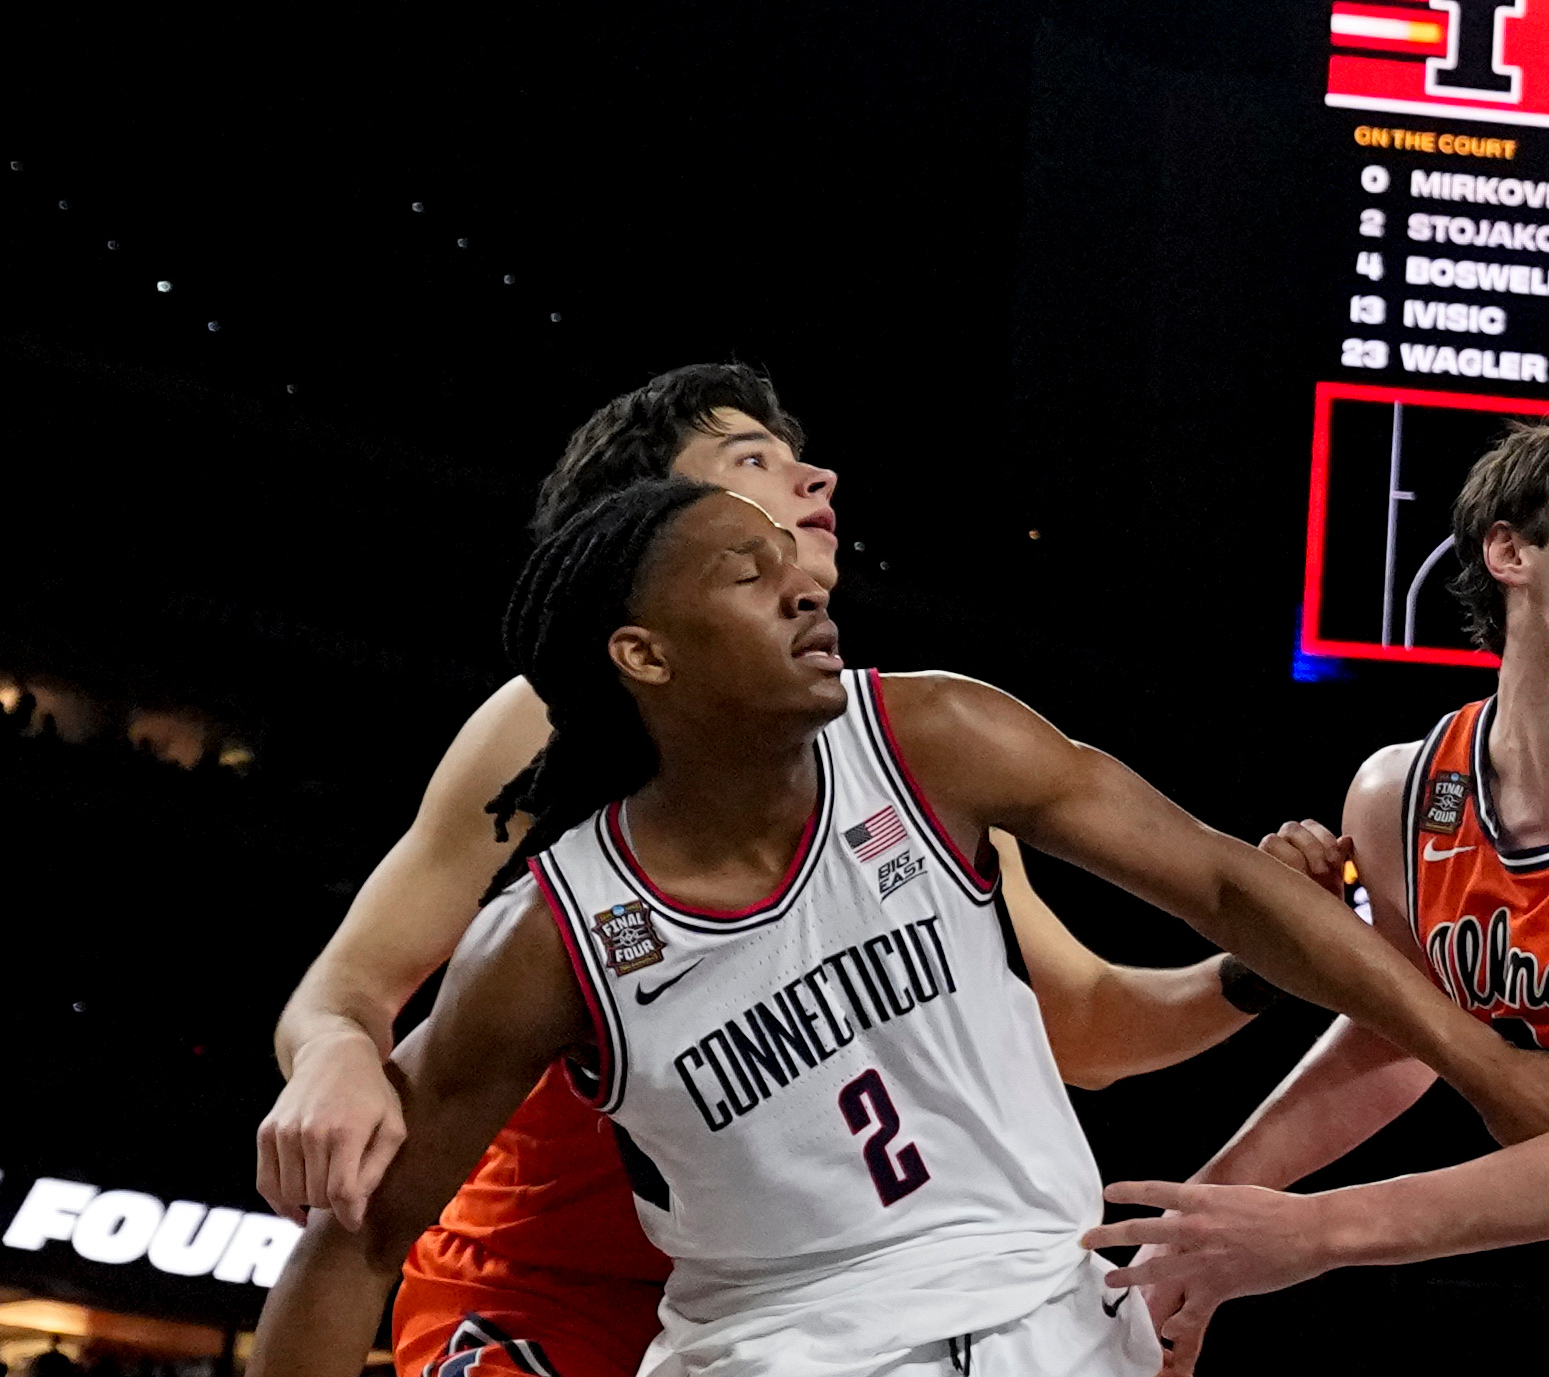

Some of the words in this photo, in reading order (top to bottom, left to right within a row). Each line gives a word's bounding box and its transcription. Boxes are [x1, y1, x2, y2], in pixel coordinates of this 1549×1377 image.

[1353, 125, 1393, 149] ON
[1391, 128, 1437, 153] THE
[1437, 133, 1517, 160] COURT
[1360, 164, 1390, 194] 0
[1359, 208, 1386, 238] 2
[1355, 251, 1384, 282] 4
[1349, 294, 1387, 325] 13
[1402, 299, 1507, 336] IVISIC
[1340, 337, 1390, 370] 23
[1399, 342, 1549, 383] WAGLER
[878, 848, 910, 879] BIG
[879, 855, 925, 894] EAST
[602, 912, 645, 937] FINAL
[615, 939, 655, 963] FOUR
[673, 916, 957, 1133] CONNECTICUT
[838, 1068, 931, 1209] 2
[3, 1176, 306, 1289] FOUR
